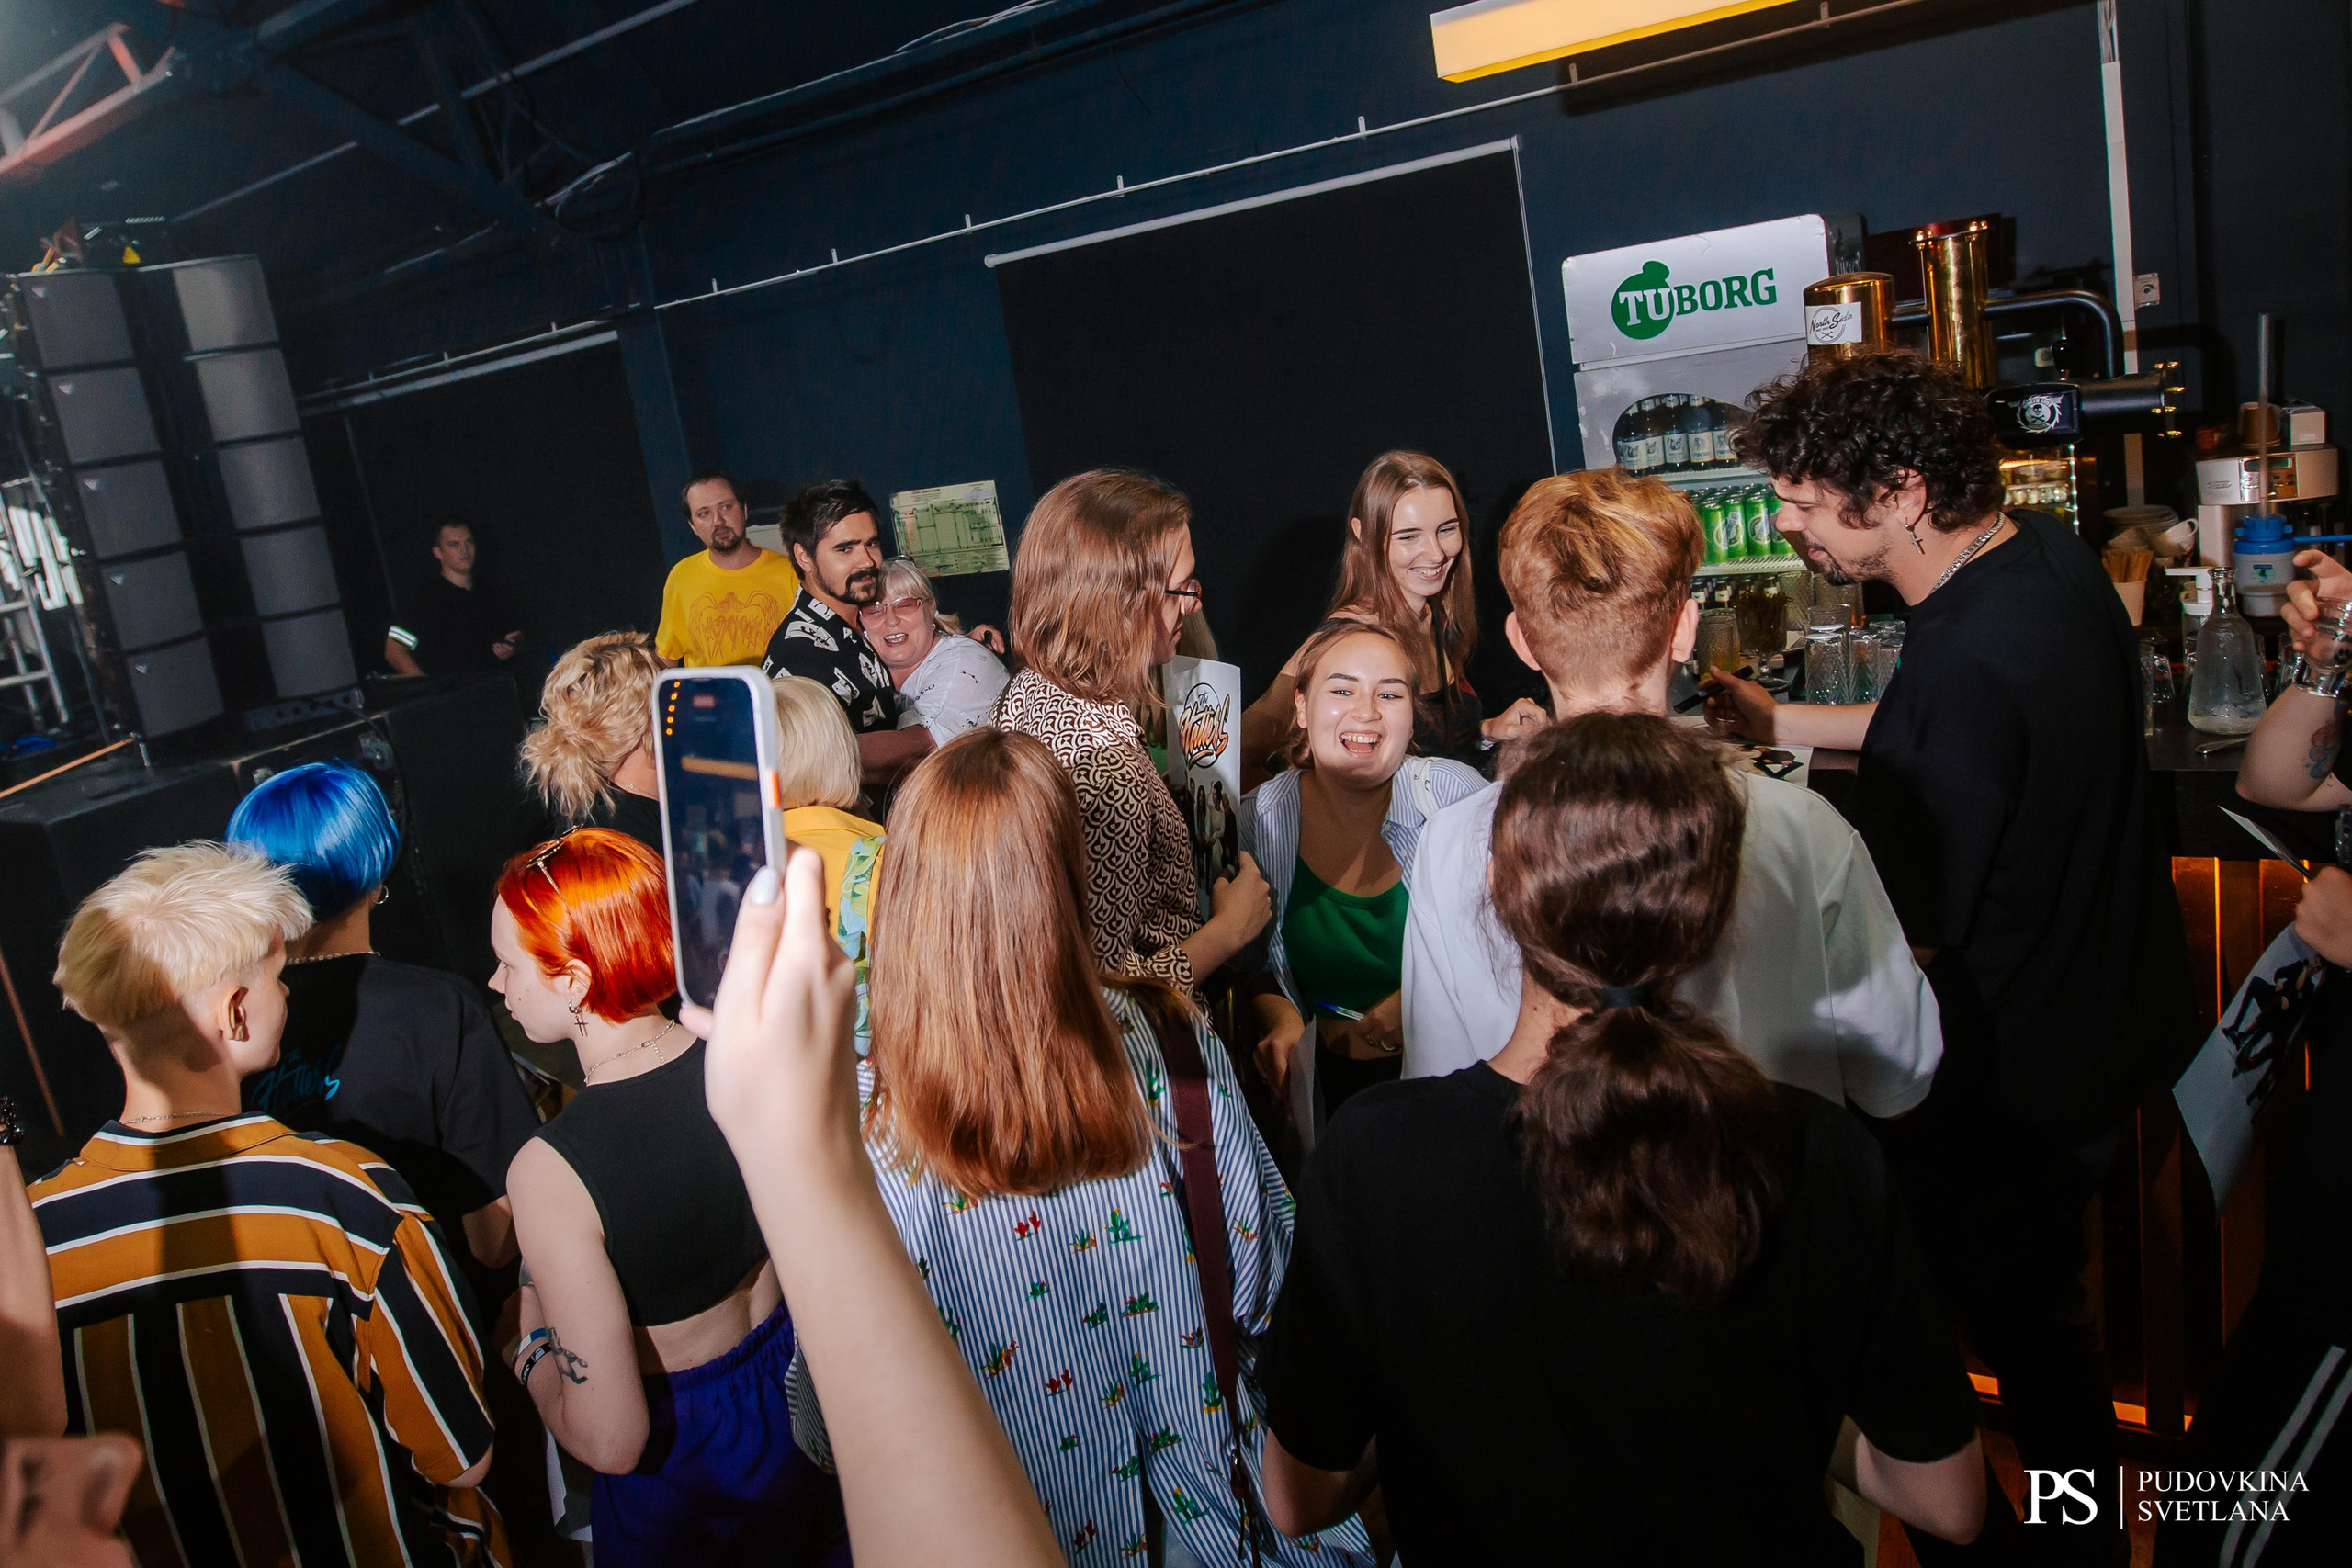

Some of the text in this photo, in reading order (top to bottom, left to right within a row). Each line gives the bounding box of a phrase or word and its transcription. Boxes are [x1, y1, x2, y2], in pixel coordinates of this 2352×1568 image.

[1619, 267, 1778, 326] TUBORG
[1809, 310, 1853, 334] North Side
[1197, 691, 1209, 705] The
